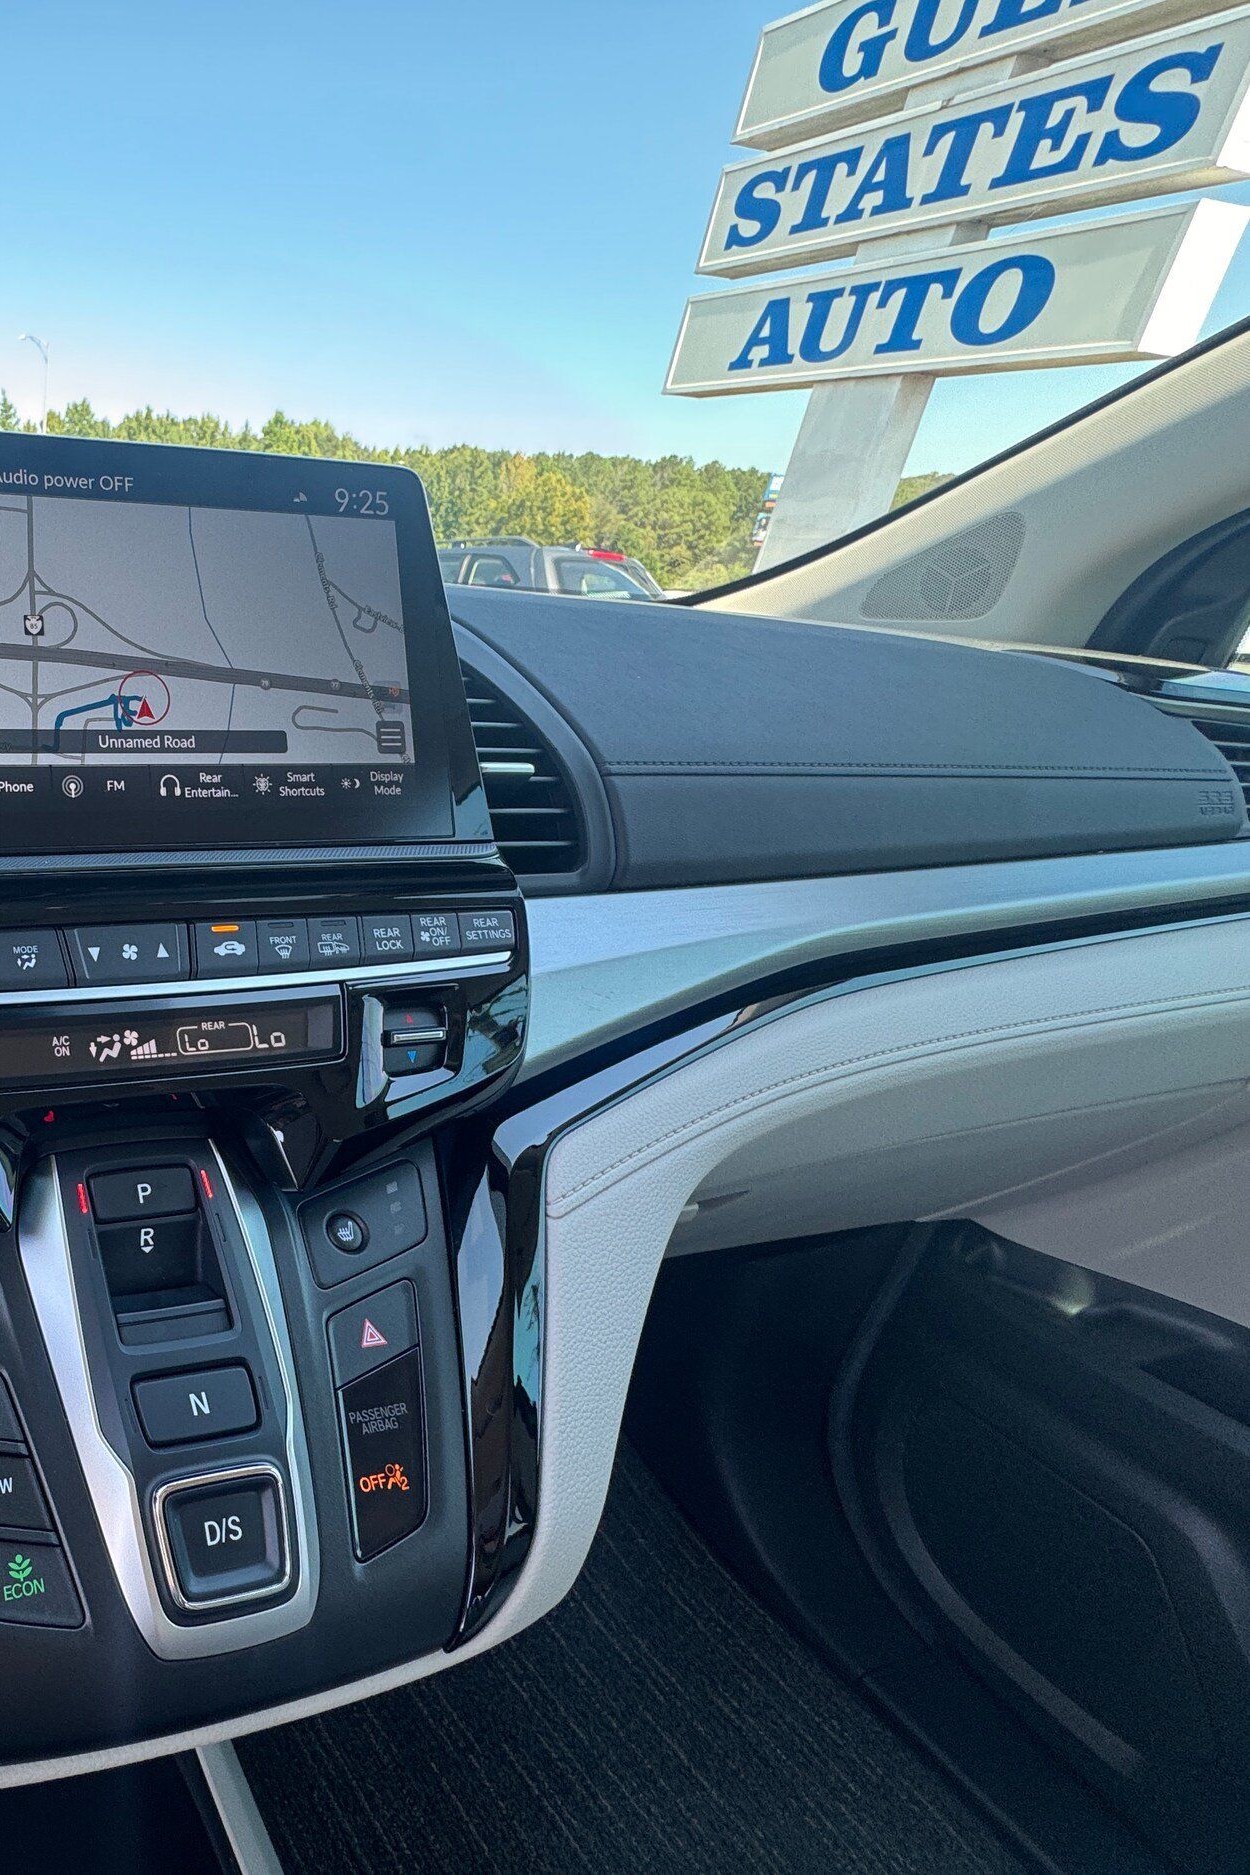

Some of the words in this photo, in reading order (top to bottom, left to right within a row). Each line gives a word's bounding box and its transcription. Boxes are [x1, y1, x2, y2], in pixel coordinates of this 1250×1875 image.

[818, 0, 1090, 93] GU
[723, 42, 1225, 251] STATES
[727, 254, 1056, 372] AUTO
[44, 473, 95, 491] power
[99, 474, 134, 492] OFF
[334, 488, 389, 516] 9:25
[98, 735, 161, 748] Unnamed
[164, 735, 196, 748] Road
[199, 772, 222, 783] Rear
[287, 772, 315, 783] Smart
[370, 772, 404, 784] Display
[107, 780, 125, 791] FM
[279, 785, 325, 797] Shortcuts
[374, 785, 402, 795] Mode
[185, 787, 239, 798] Entertain...
[419, 917, 447, 927] REAR
[473, 918, 499, 928] REAR
[321, 932, 343, 942] REAR
[373, 927, 401, 938] REAR
[429, 927, 448, 938] ON/
[465, 929, 512, 940] SETTINGS
[269, 935, 297, 946] FRONT
[376, 940, 403, 950] LOCK
[432, 936, 451, 947] OFF
[13, 945, 38, 955] MODE
[202, 1020, 226, 1031] REAR
[52, 1035, 70, 1047] A/C
[54, 1046, 71, 1057] ON
[136, 1183, 152, 1204] P
[140, 1228, 155, 1247] R
[190, 1392, 211, 1417] N
[348, 1402, 409, 1424] PASSENGER
[362, 1417, 399, 1435] AIRBAG
[359, 1473, 386, 1492] OFF
[204, 1516, 243, 1547] D/S
[3, 1578, 46, 1602] ECON
